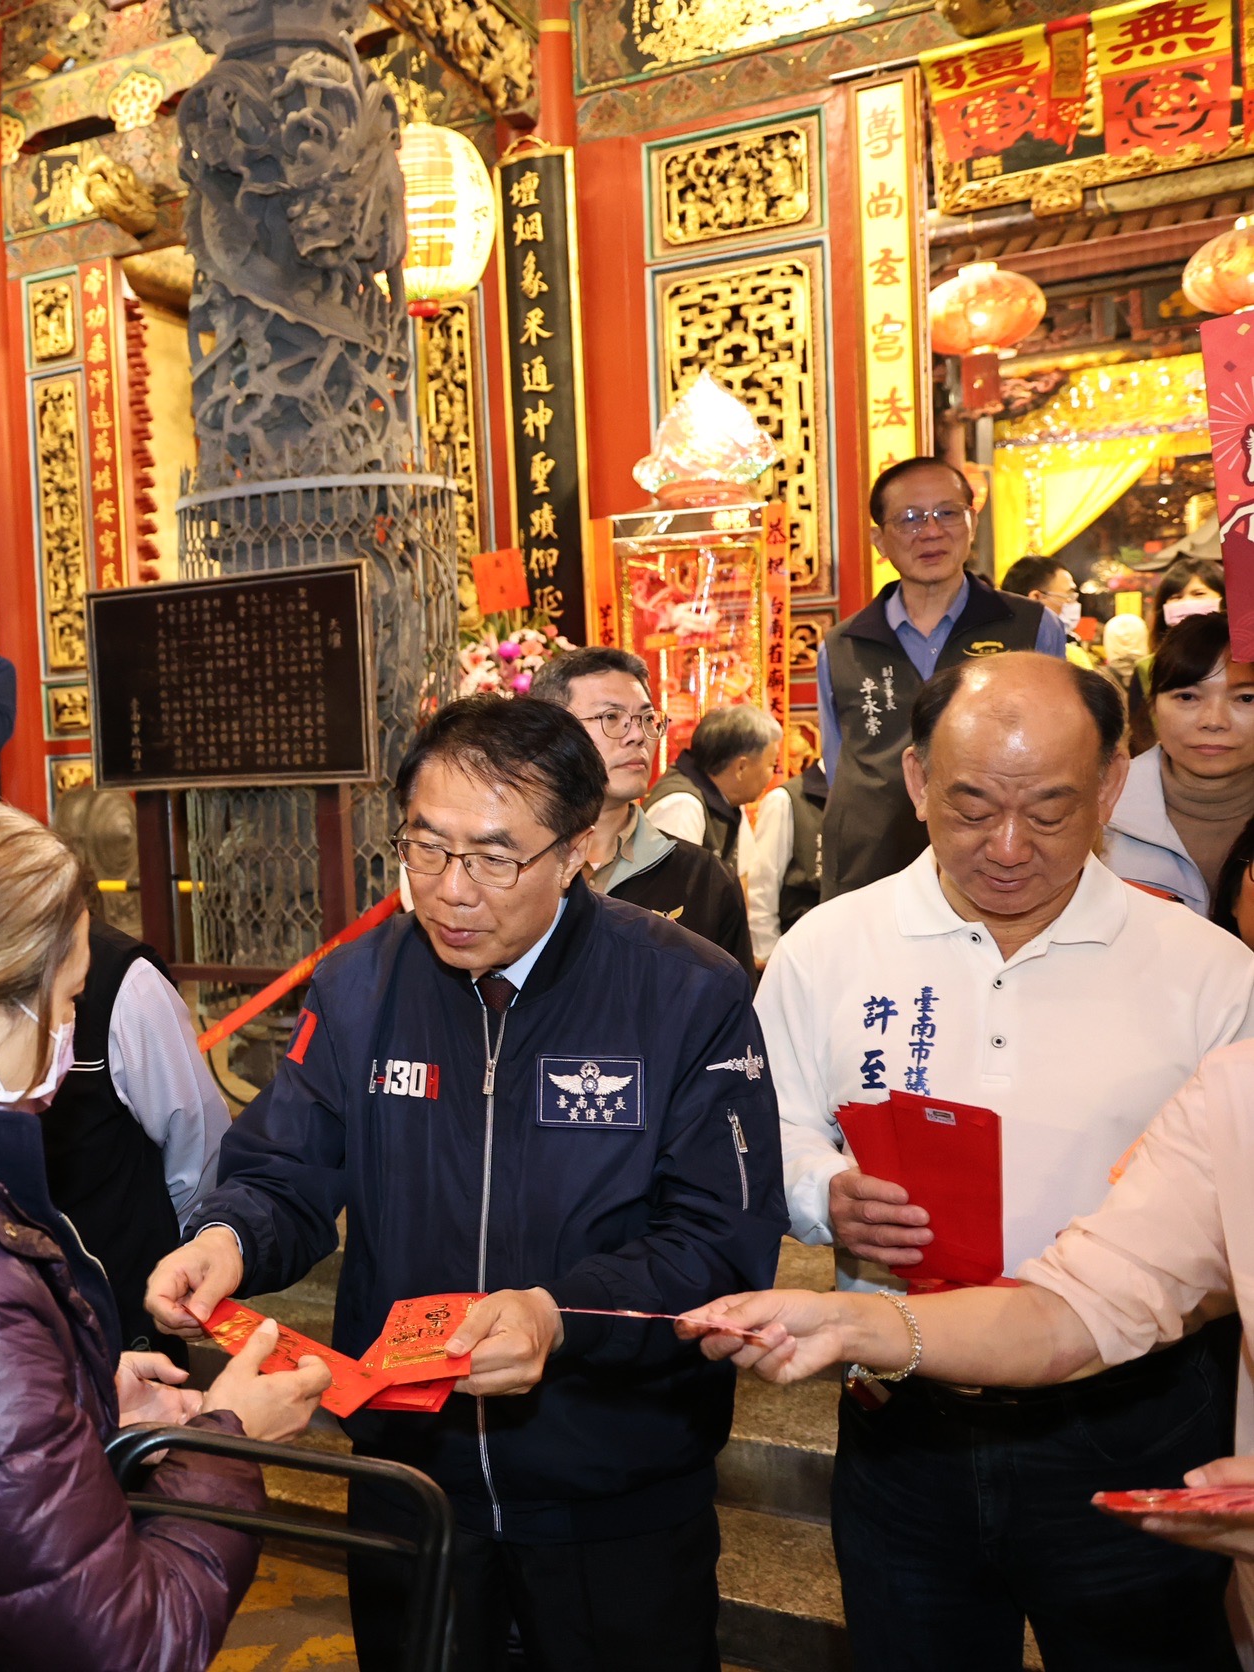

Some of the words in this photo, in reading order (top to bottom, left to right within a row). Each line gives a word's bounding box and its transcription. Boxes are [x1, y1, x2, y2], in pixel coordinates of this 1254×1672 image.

[1107, 1, 1225, 65] 無
[860, 996, 899, 1089] 許至
[904, 986, 939, 1097] 臺南市議
[556, 1094, 627, 1110] 臺南市長
[568, 1107, 615, 1122] 黃偉哲
